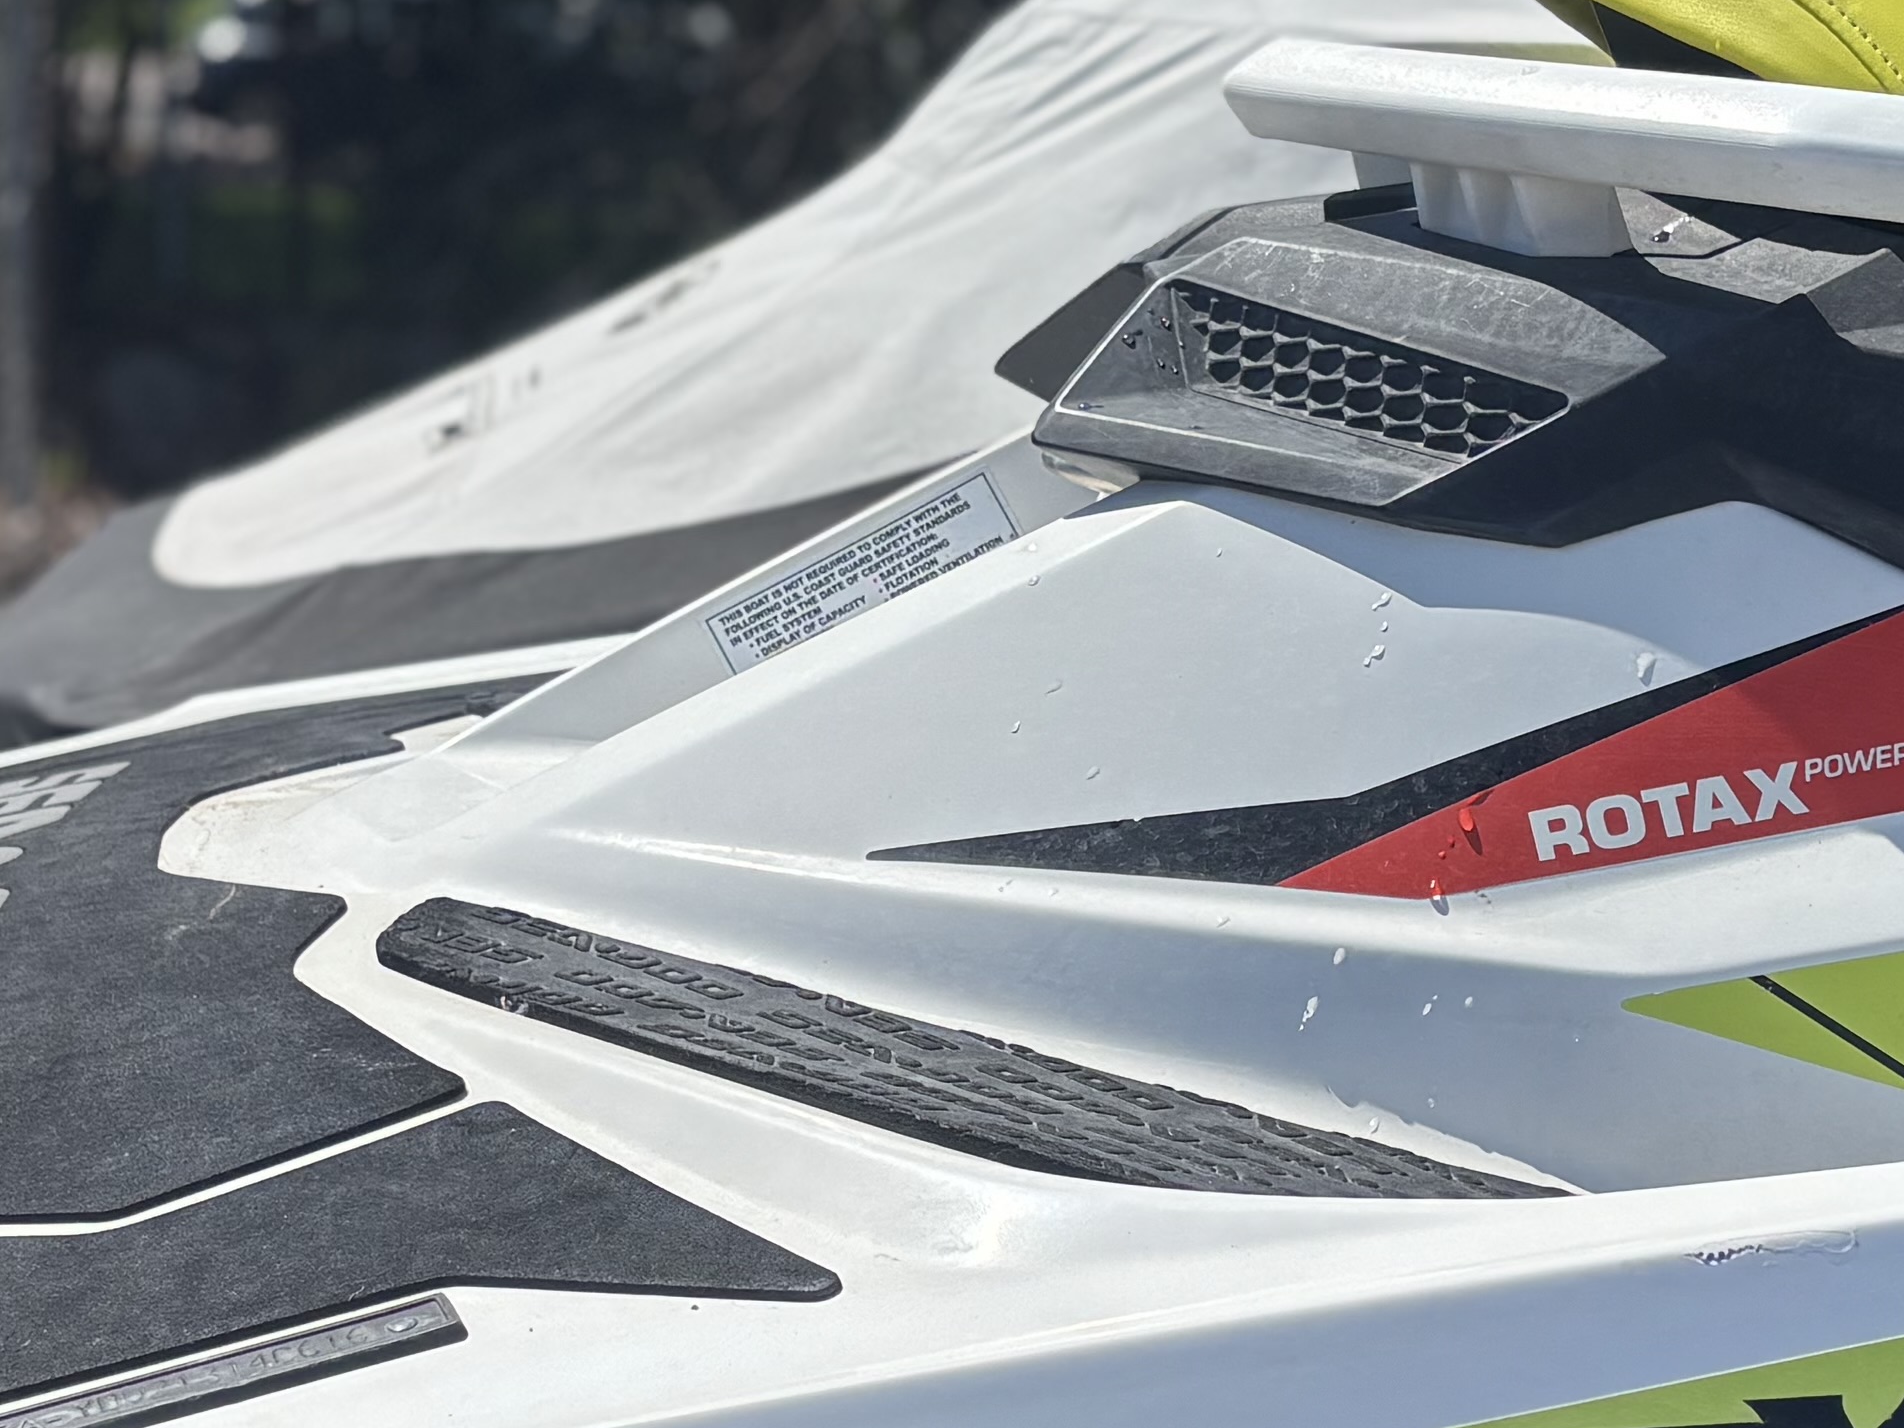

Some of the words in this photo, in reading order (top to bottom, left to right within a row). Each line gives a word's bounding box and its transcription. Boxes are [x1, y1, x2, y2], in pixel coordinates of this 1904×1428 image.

[718, 608, 743, 626] THIS
[744, 596, 770, 616] BOAT
[772, 588, 783, 599] IS
[785, 578, 804, 594] NOT
[807, 550, 856, 582] REQUIRED
[857, 542, 872, 554] TO
[872, 520, 912, 546] COMPLY
[912, 506, 940, 524] WITH
[940, 492, 962, 509] THE
[724, 603, 782, 637] FOLLOWING
[804, 576, 837, 596] COAST
[838, 556, 873, 580] GUARD
[874, 534, 912, 558] SAFETY
[912, 501, 971, 536] STANDARDS
[879, 564, 905, 581] SAFE
[904, 538, 950, 566] LOADING
[884, 558, 939, 591] FLOTATION
[938, 535, 1004, 574] VENTILATION
[730, 634, 742, 648] IN
[742, 618, 779, 642] EFFECT
[781, 607, 798, 620] ON
[797, 595, 819, 612] THE
[820, 583, 846, 600] DATE
[846, 573, 861, 586] OF
[862, 534, 938, 578] CERTIFICATION:
[756, 629, 781, 647] FUEL
[782, 606, 824, 633] SYSTEM
[761, 632, 802, 657] DISPLAY
[803, 622, 817, 634] OF
[818, 595, 868, 626] CAPACITY
[1527, 761, 1810, 862] ROTAX
